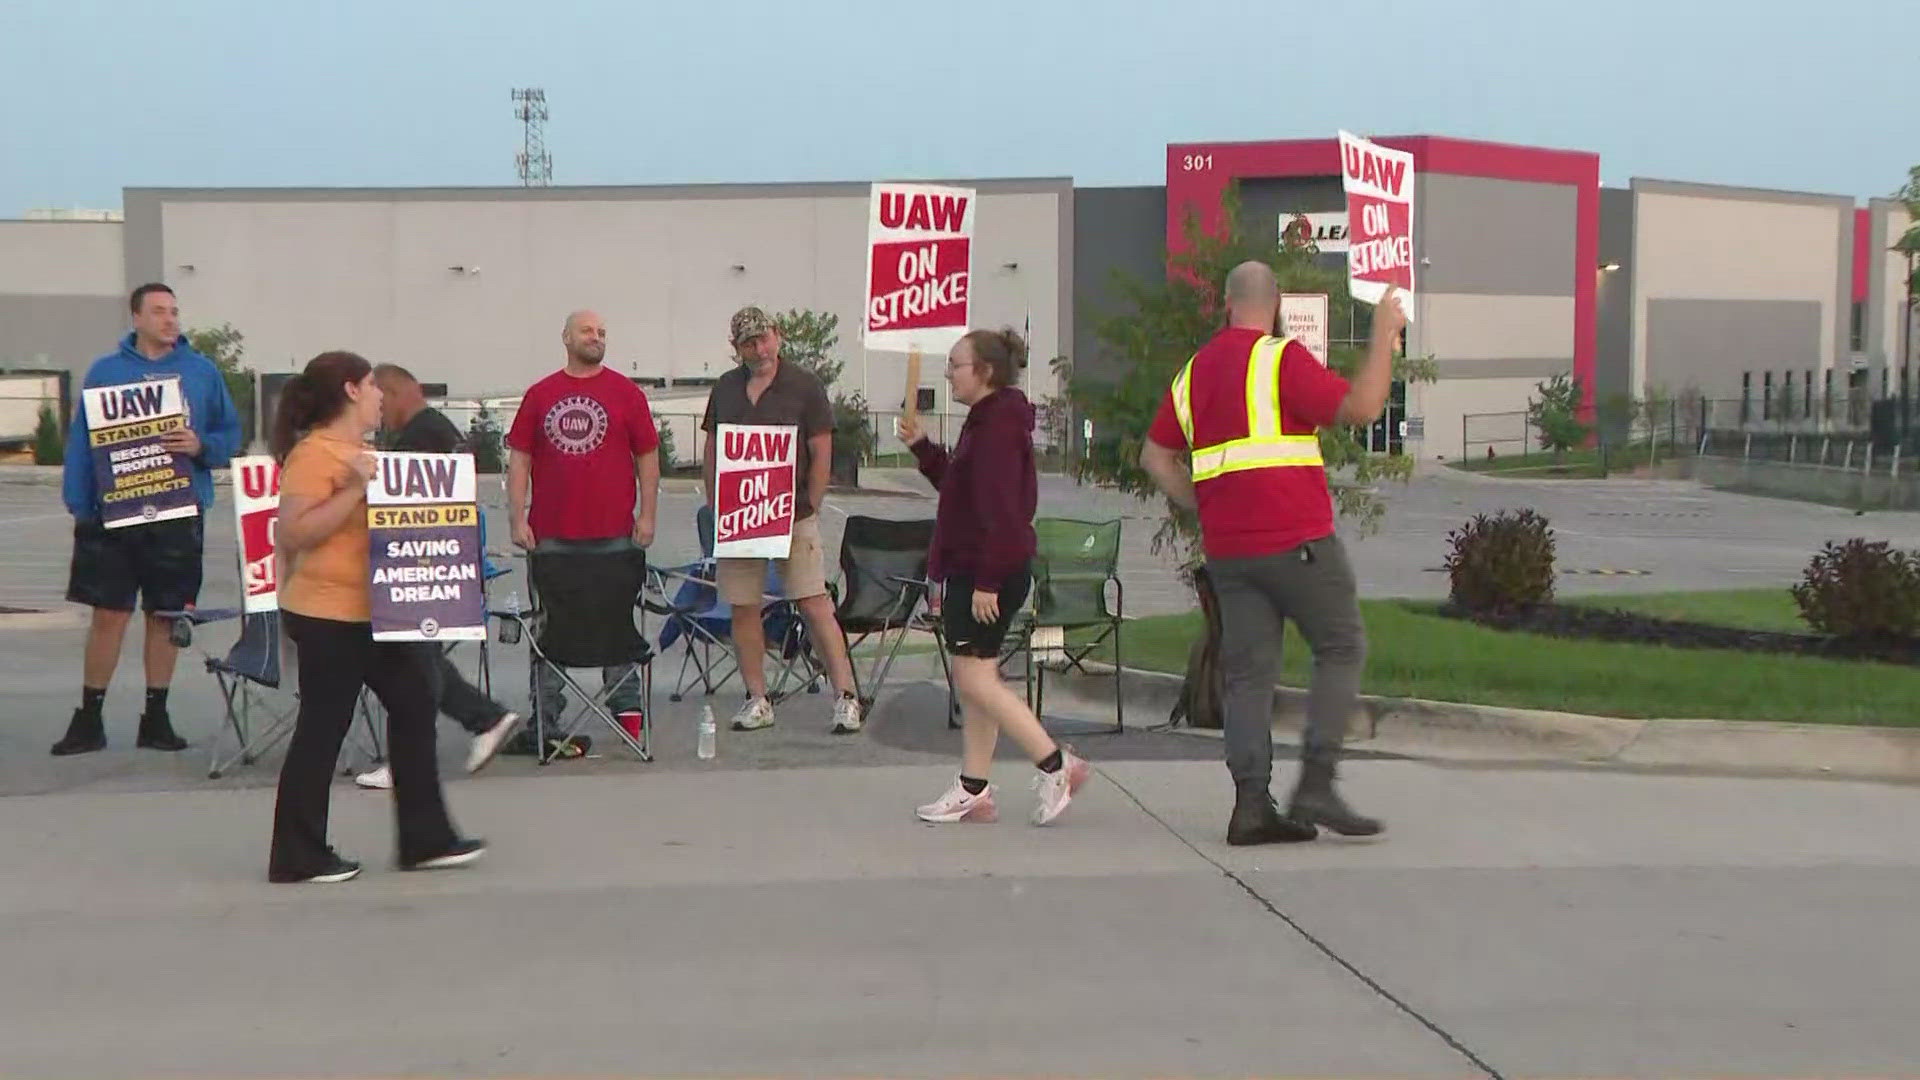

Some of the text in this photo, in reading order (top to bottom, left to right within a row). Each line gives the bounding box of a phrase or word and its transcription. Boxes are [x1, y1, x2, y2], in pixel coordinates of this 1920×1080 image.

[1183, 154, 1212, 170] 301
[1344, 142, 1405, 196] UAW
[880, 192, 968, 232] UAW
[1362, 203, 1390, 236] ON
[898, 243, 938, 284] ON
[1351, 236, 1410, 277] STRIKE
[870, 271, 968, 328] STRIKE
[100, 384, 164, 420] UAW
[95, 419, 178, 445] STAND UP
[562, 417, 590, 431] UAW
[109, 443, 167, 463] RECOR
[724, 431, 791, 462] UAW
[112, 454, 174, 475] PROFITS
[114, 468, 176, 488] RECORD
[383, 457, 457, 498] UAW
[104, 477, 191, 503] CONTRACTS
[740, 471, 769, 504] ON
[375, 509, 470, 526] STAND UP
[719, 492, 793, 540] STRIKE
[387, 538, 460, 558] SAVING
[373, 564, 477, 585] AMERICAN
[390, 584, 461, 603] DREAM
